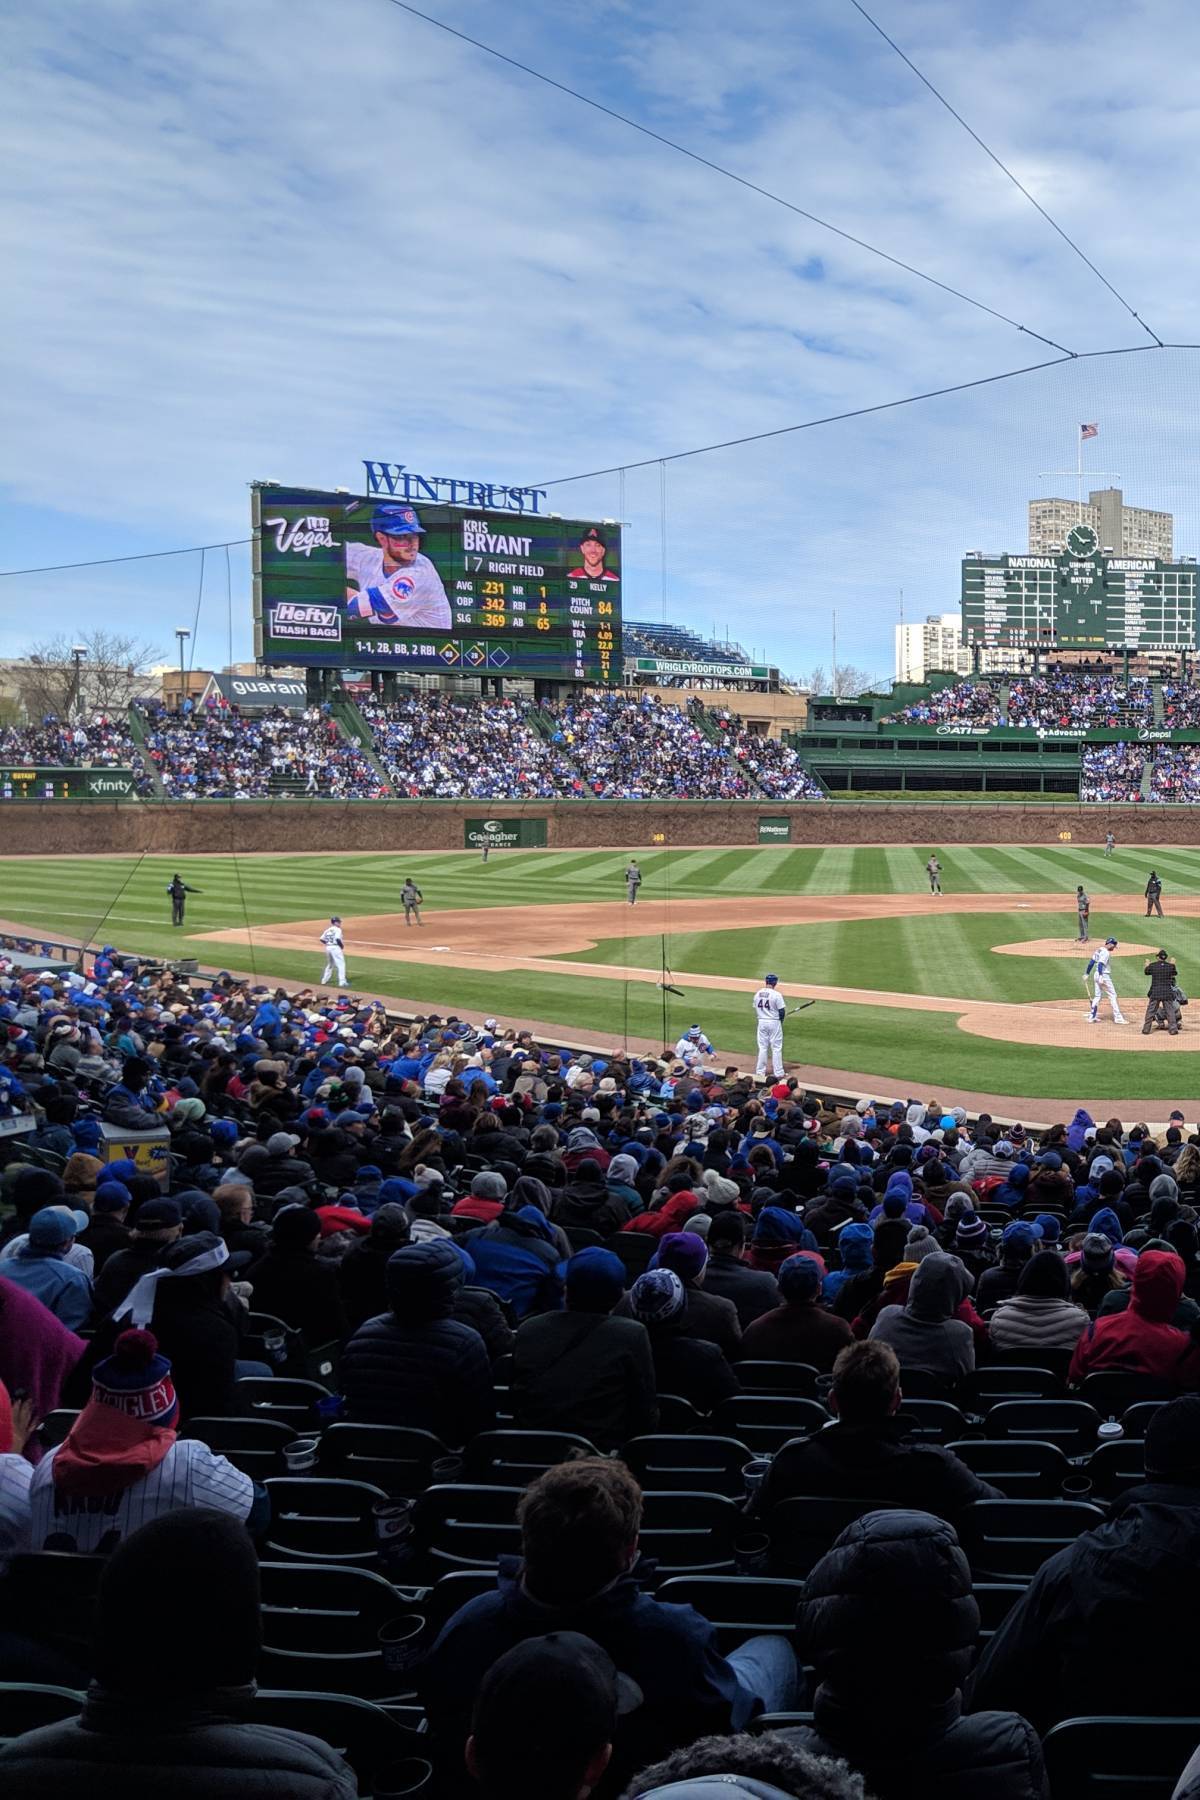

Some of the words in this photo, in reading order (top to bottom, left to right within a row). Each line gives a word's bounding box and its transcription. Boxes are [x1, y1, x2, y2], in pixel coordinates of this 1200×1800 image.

[362, 460, 547, 514] WINTRUST
[463, 519, 488, 534] KRIS
[265, 517, 341, 558] Vegas
[463, 532, 532, 557] BRYANT
[464, 556, 483, 573] 17
[489, 561, 517, 575] RIGHT
[519, 563, 544, 577] FIELD
[1008, 557, 1057, 568] NATIONAL
[1107, 559, 1155, 570] AMERICAN
[456, 580, 473, 591] AVG
[482, 581, 505, 595] .231
[512, 586, 524, 595] HR
[540, 586, 547, 599] 1
[589, 583, 607, 592] KELLY
[1076, 584, 1090, 595] 17
[456, 596, 473, 606] OBP
[482, 598, 506, 611] .342
[512, 600, 526, 610] RBI
[539, 602, 547, 614] 8
[570, 597, 591, 607] PITCH
[570, 606, 593, 615] COUNT
[598, 601, 613, 615] 84
[278, 605, 333, 625] Hefty
[456, 613, 472, 623] SLG
[482, 614, 506, 627] .369
[512, 618, 524, 627] AB
[536, 618, 550, 631] 65
[274, 625, 308, 636] TRASH
[310, 626, 338, 637] BAGS
[572, 630, 586, 639] ERA
[356, 641, 374, 653] 1-1,
[377, 642, 392, 654] 2B,
[394, 643, 410, 656] BB,
[412, 644, 419, 655] 2
[420, 645, 436, 656] RBI
[576, 640, 584, 648] IP
[576, 650, 582, 658] H
[601, 651, 610, 659] 22
[601, 661, 610, 669] 21
[656, 661, 752, 677] WRIGLEYROOFTOPS.COM
[574, 669, 585, 678] BB
[950, 727, 971, 735] ATI
[1048, 729, 1086, 737] Advocate
[1150, 731, 1171, 739] pepsi
[89, 779, 132, 794] xfinity
[468, 832, 518, 842] Gaagher
[757, 999, 771, 1011] 44
